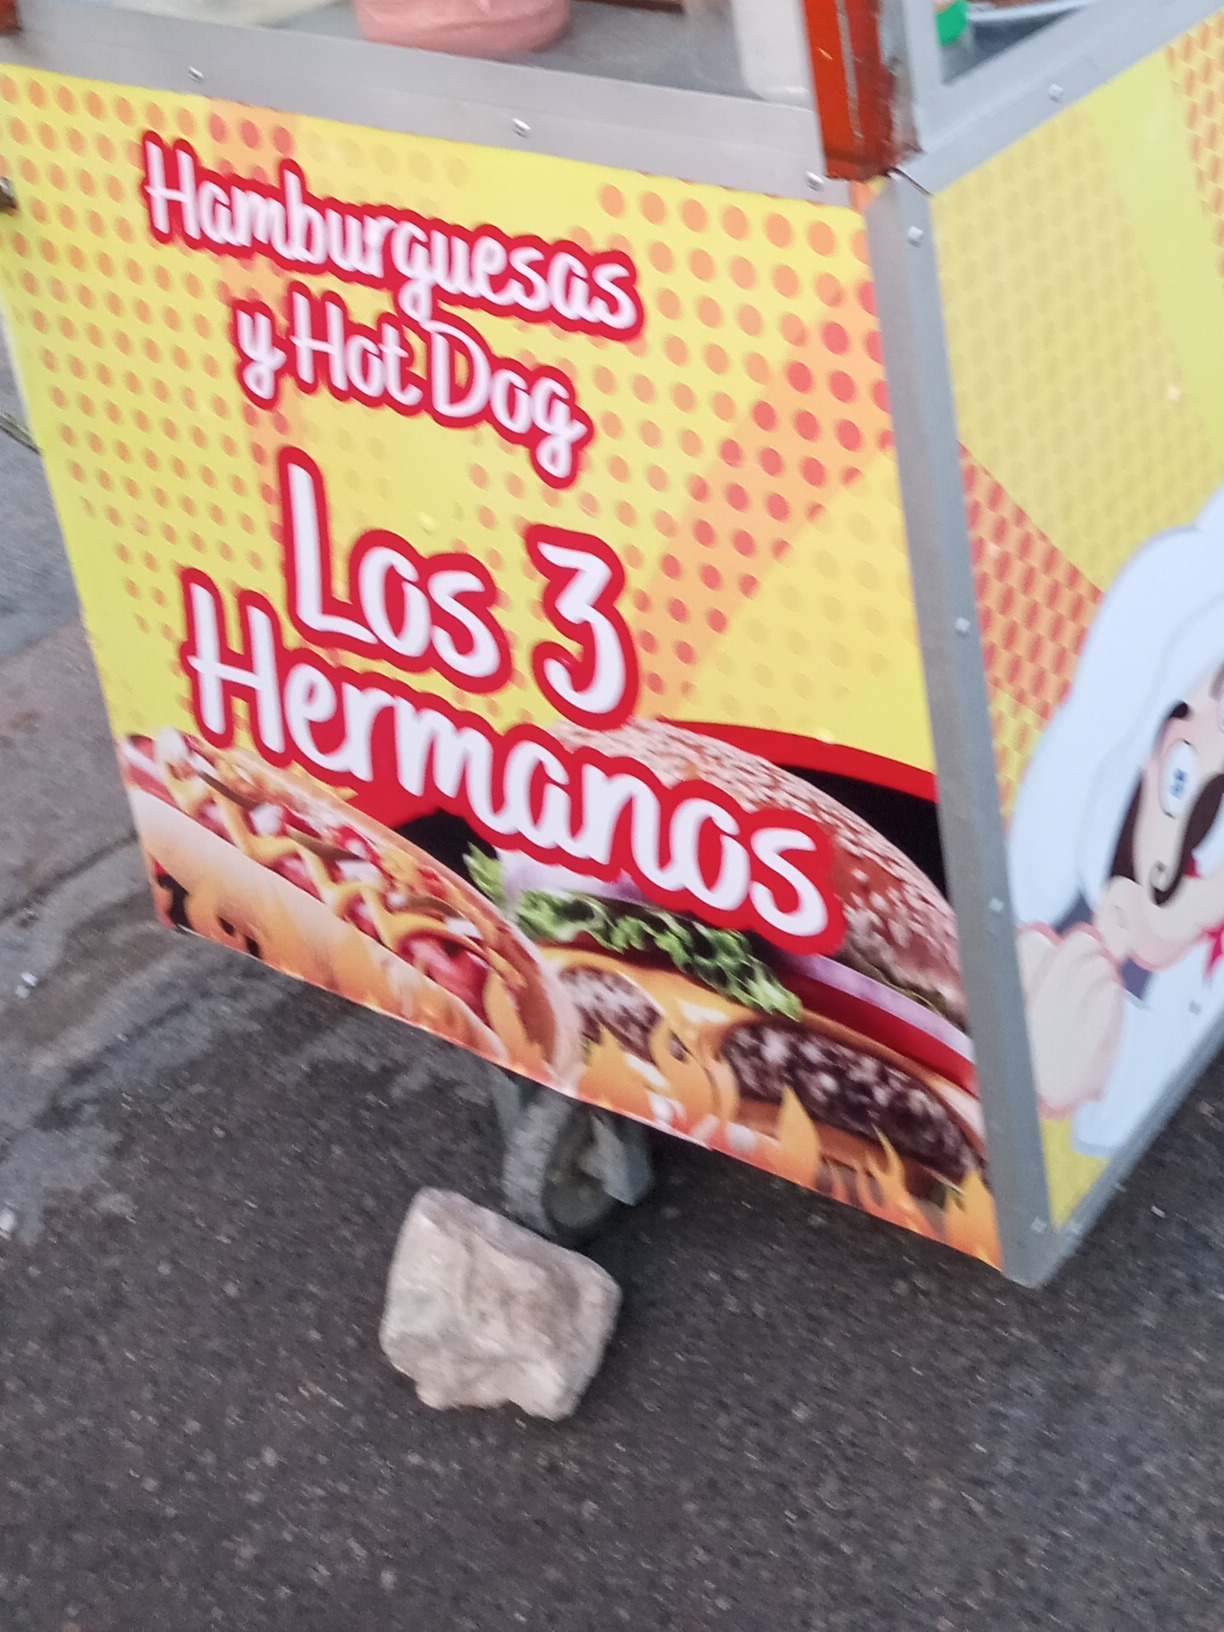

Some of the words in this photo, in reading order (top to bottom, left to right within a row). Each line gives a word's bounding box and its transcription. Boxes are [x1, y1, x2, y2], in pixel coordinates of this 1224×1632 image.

[141, 133, 643, 339] Hamburguesas
[233, 297, 286, 408] y
[286, 284, 426, 410] Hot
[424, 318, 592, 486] Dog
[281, 448, 508, 692] Los
[526, 526, 638, 728] 3
[183, 569, 845, 955] Hermanos
